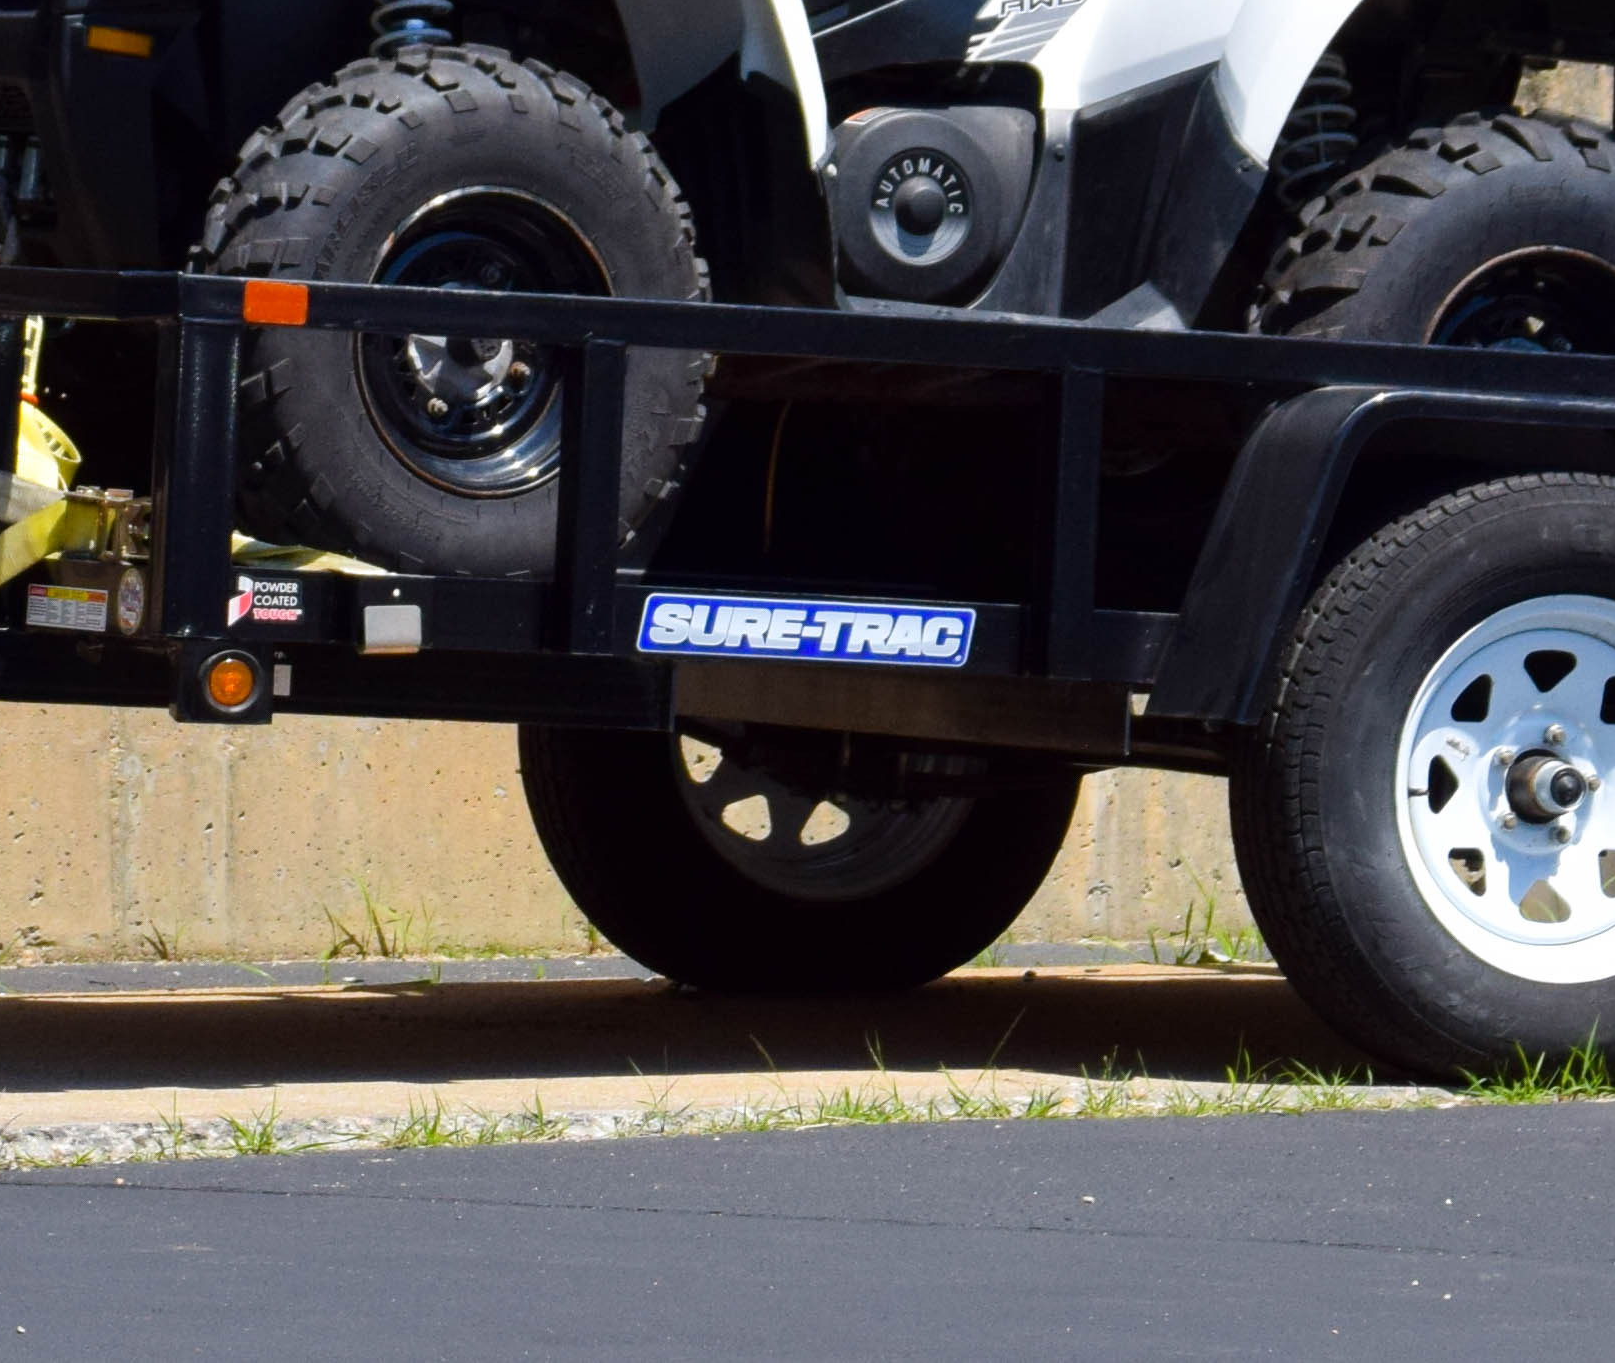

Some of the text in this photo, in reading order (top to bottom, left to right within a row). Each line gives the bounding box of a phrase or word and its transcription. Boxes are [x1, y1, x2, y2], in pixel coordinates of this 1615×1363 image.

[876, 157, 963, 215] AUTOMATIC
[253, 581, 298, 593] POWDER
[253, 595, 298, 606] COATED
[253, 608, 298, 620] TOUGH
[649, 603, 964, 658] SURE-TRAC
